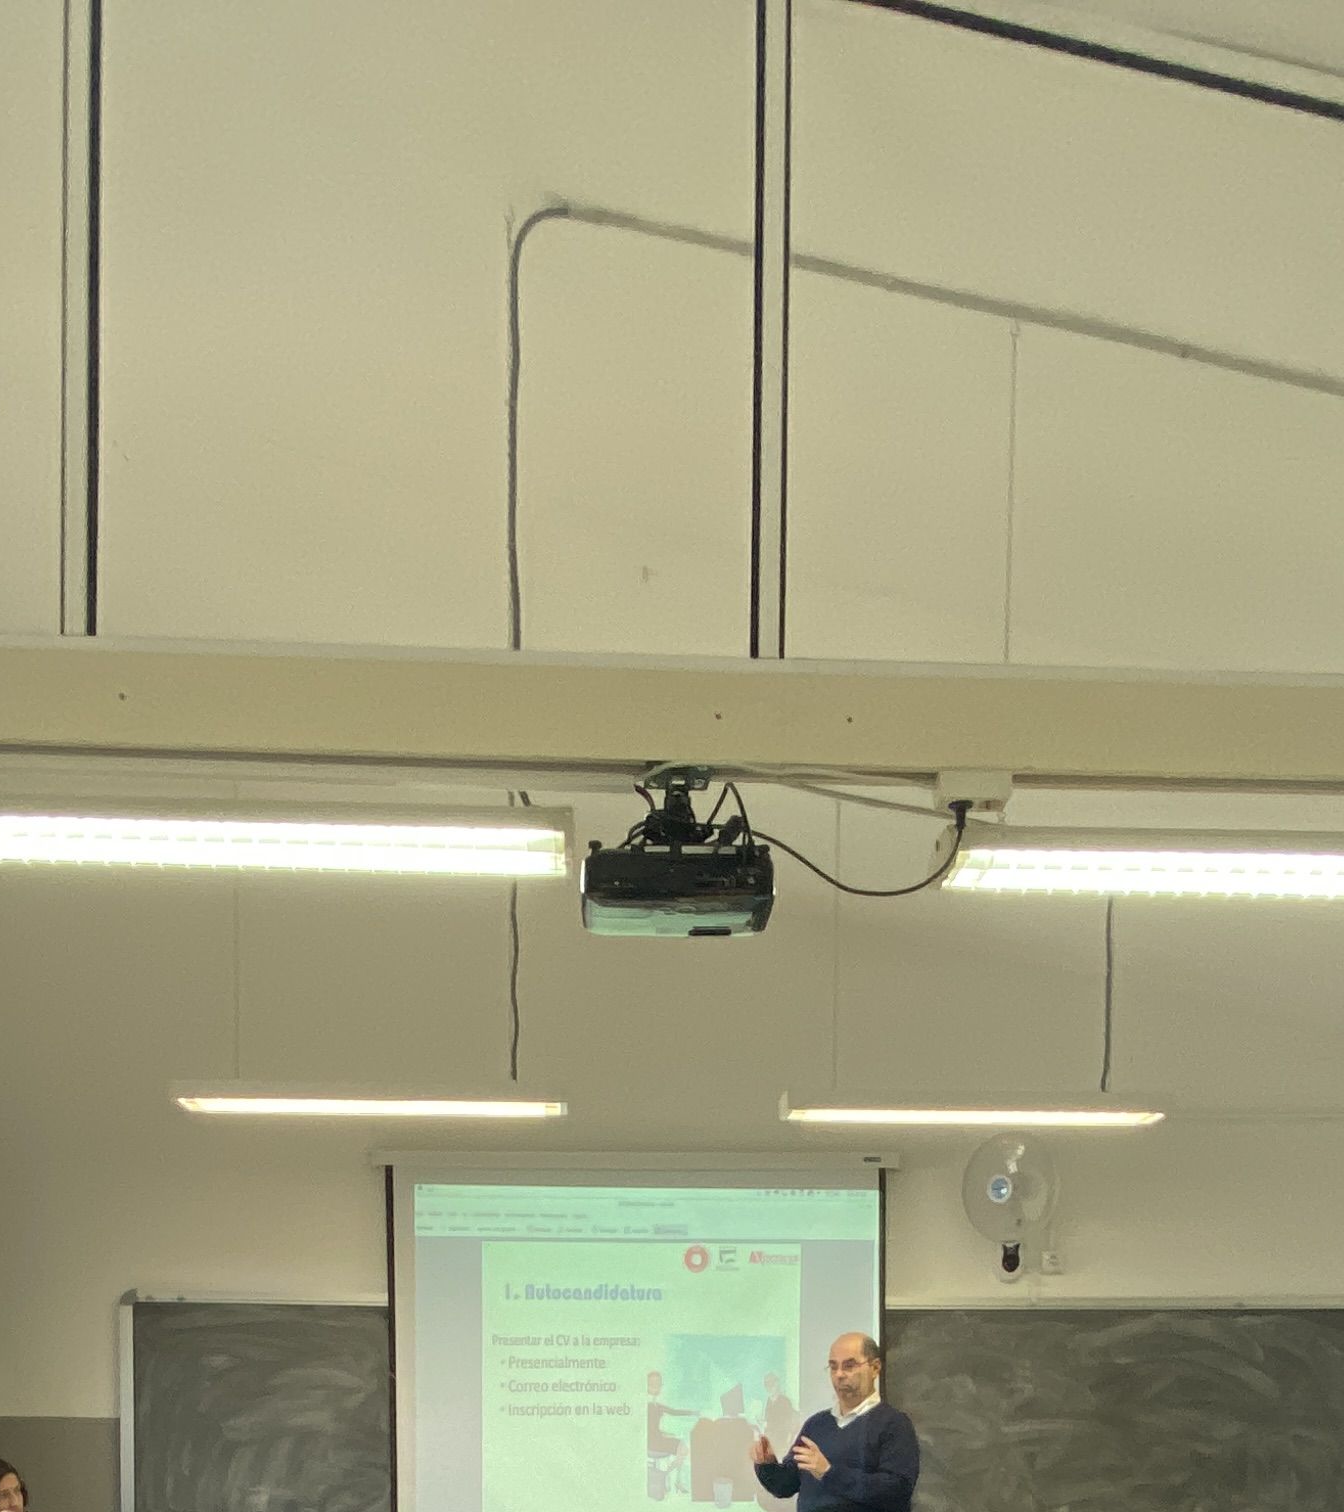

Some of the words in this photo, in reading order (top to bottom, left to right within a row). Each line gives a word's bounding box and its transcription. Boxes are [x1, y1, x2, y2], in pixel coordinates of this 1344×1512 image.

[525, 1284, 662, 1300] Autocandidatura
[492, 1334, 541, 1346] Presentar
[593, 1336, 640, 1349] empresa:
[508, 1356, 606, 1369] Presencialmente
[508, 1380, 548, 1392] Correo
[551, 1378, 617, 1392] electrónico
[508, 1403, 571, 1418] Inscripción
[605, 1403, 631, 1415] web
